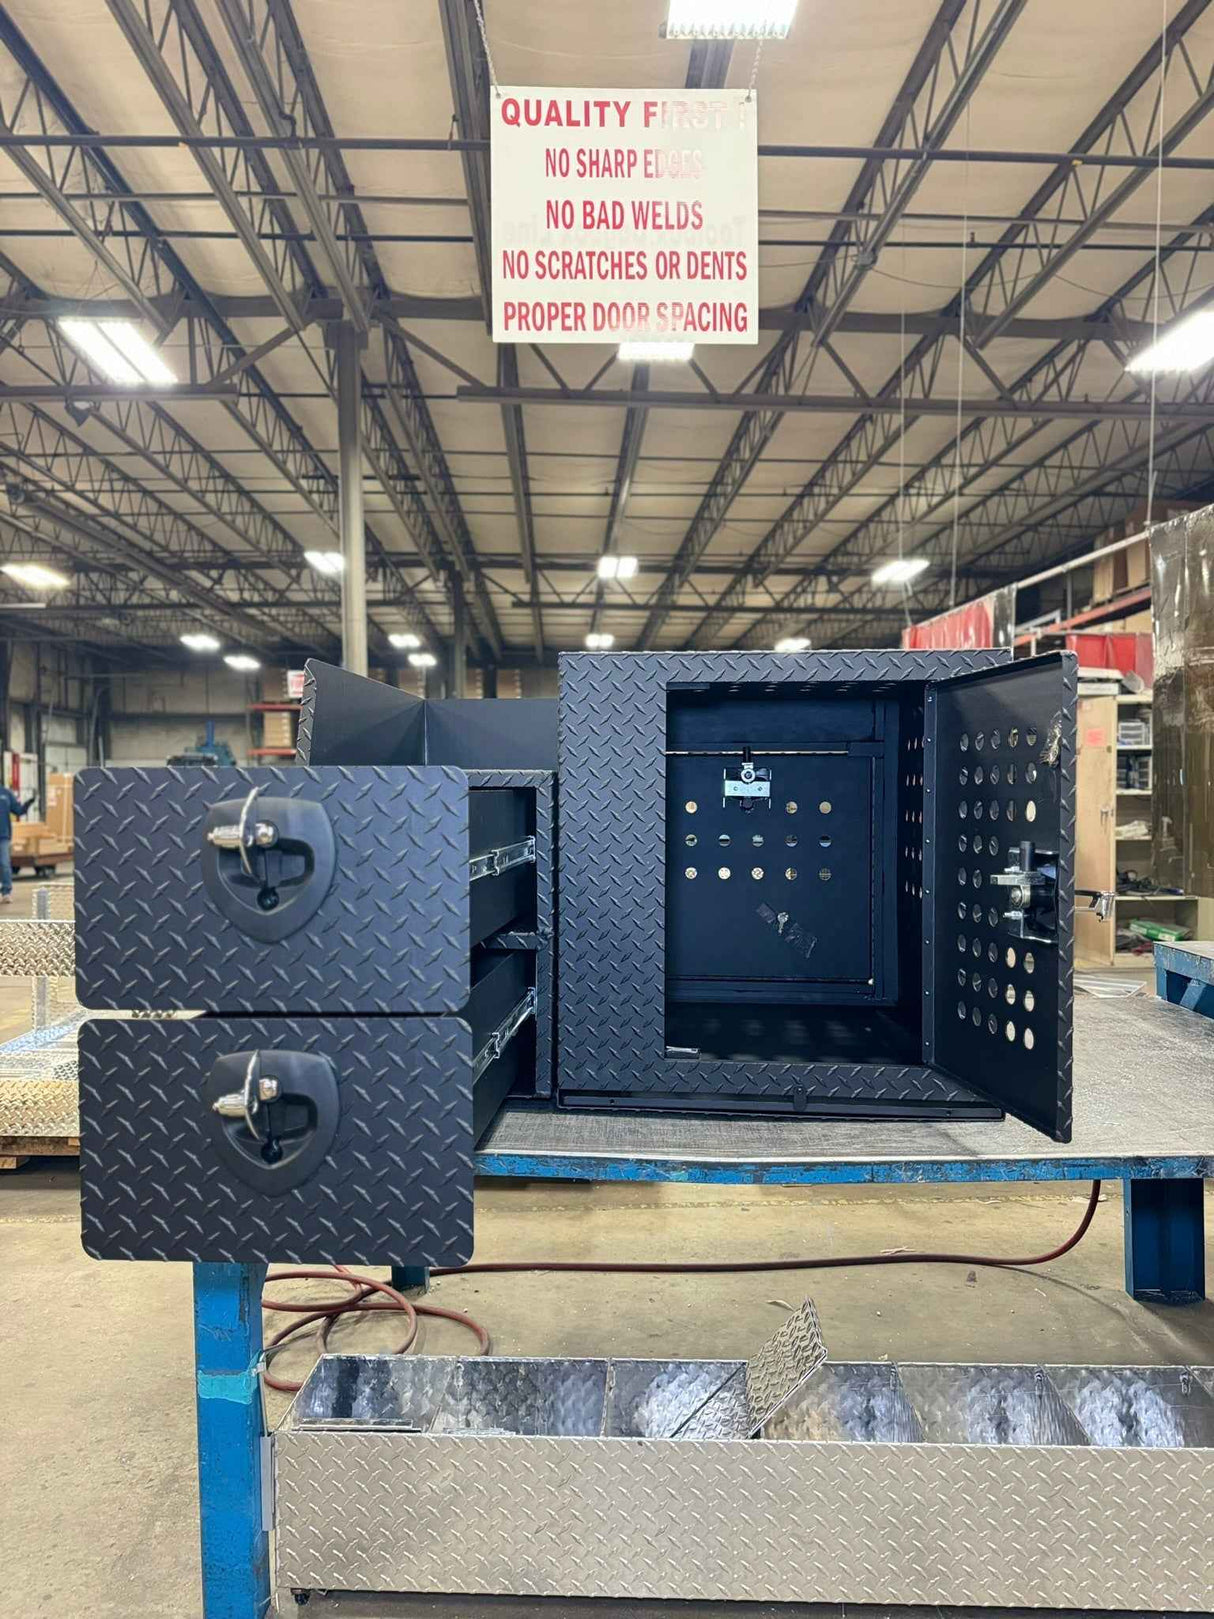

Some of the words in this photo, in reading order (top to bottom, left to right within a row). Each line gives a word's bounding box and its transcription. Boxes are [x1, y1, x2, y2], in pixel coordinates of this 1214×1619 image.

[501, 98, 631, 128] QUALITY
[545, 148, 570, 178] NO
[576, 148, 638, 178] SHARP
[643, 149, 704, 179] EDGES
[546, 200, 575, 230] NO
[582, 200, 625, 230] BAD
[631, 200, 704, 230] WELDS
[502, 250, 529, 279] NO
[534, 250, 648, 280] SCRATCHES
[655, 251, 681, 280] OR
[686, 251, 747, 280] DENTS
[503, 301, 586, 332] PROPER
[592, 301, 650, 332] DOOR
[656, 301, 748, 333] SPACING
